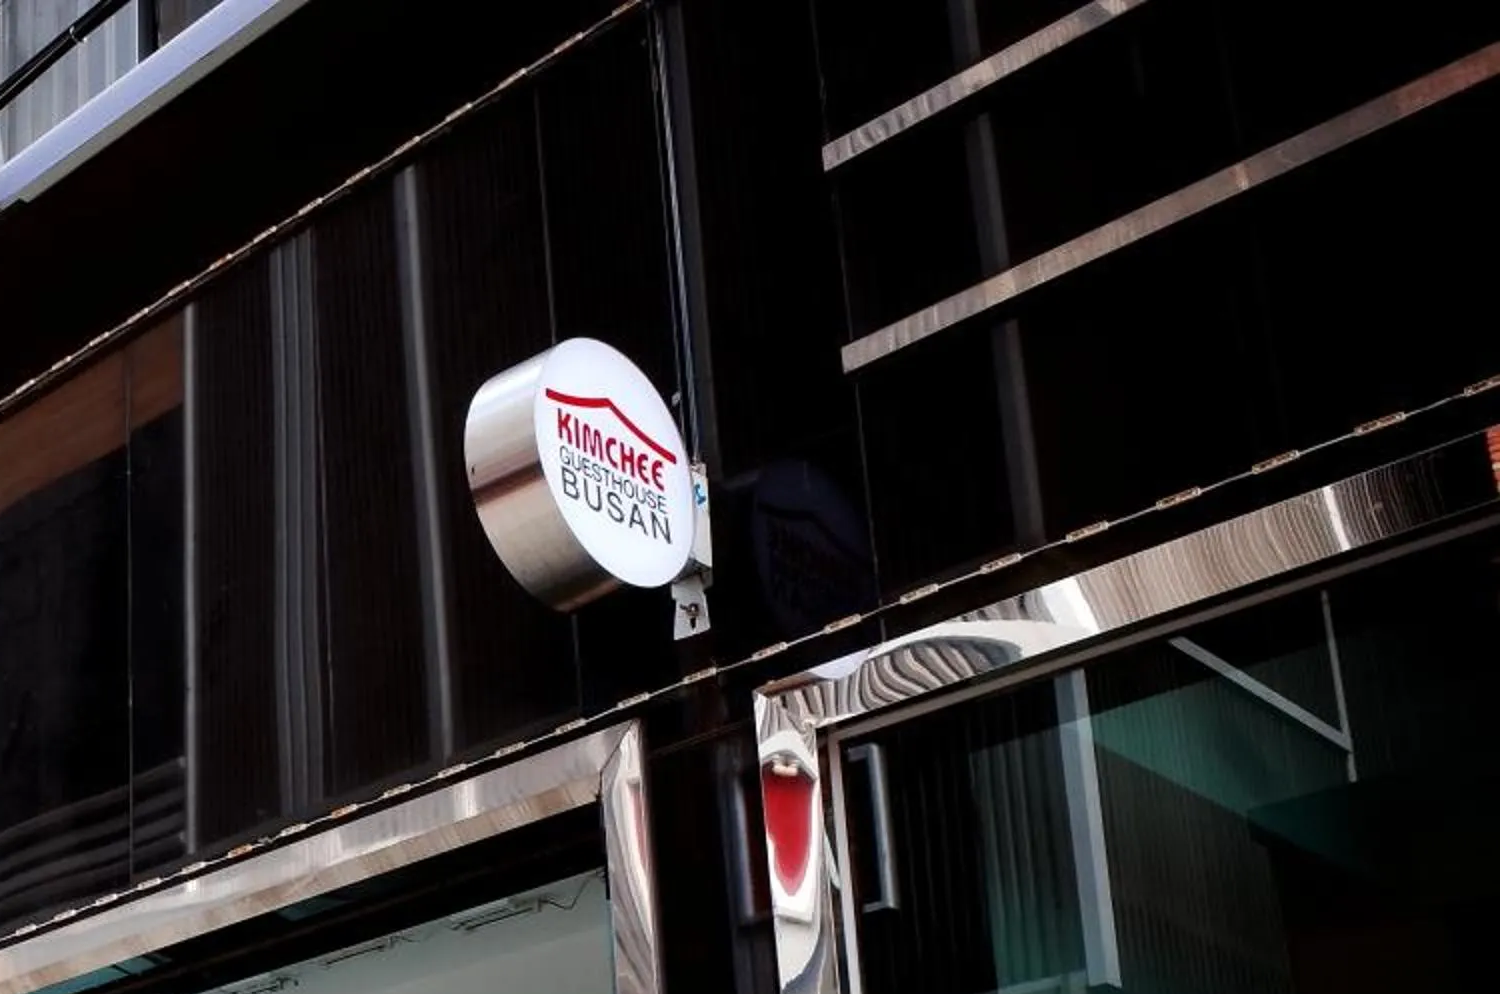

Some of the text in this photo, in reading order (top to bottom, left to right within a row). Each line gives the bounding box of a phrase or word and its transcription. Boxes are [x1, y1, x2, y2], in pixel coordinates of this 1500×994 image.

[557, 407, 665, 492] KIMCHEE
[558, 445, 667, 515] GUESTHOUSE
[560, 466, 673, 545] BUSAN
